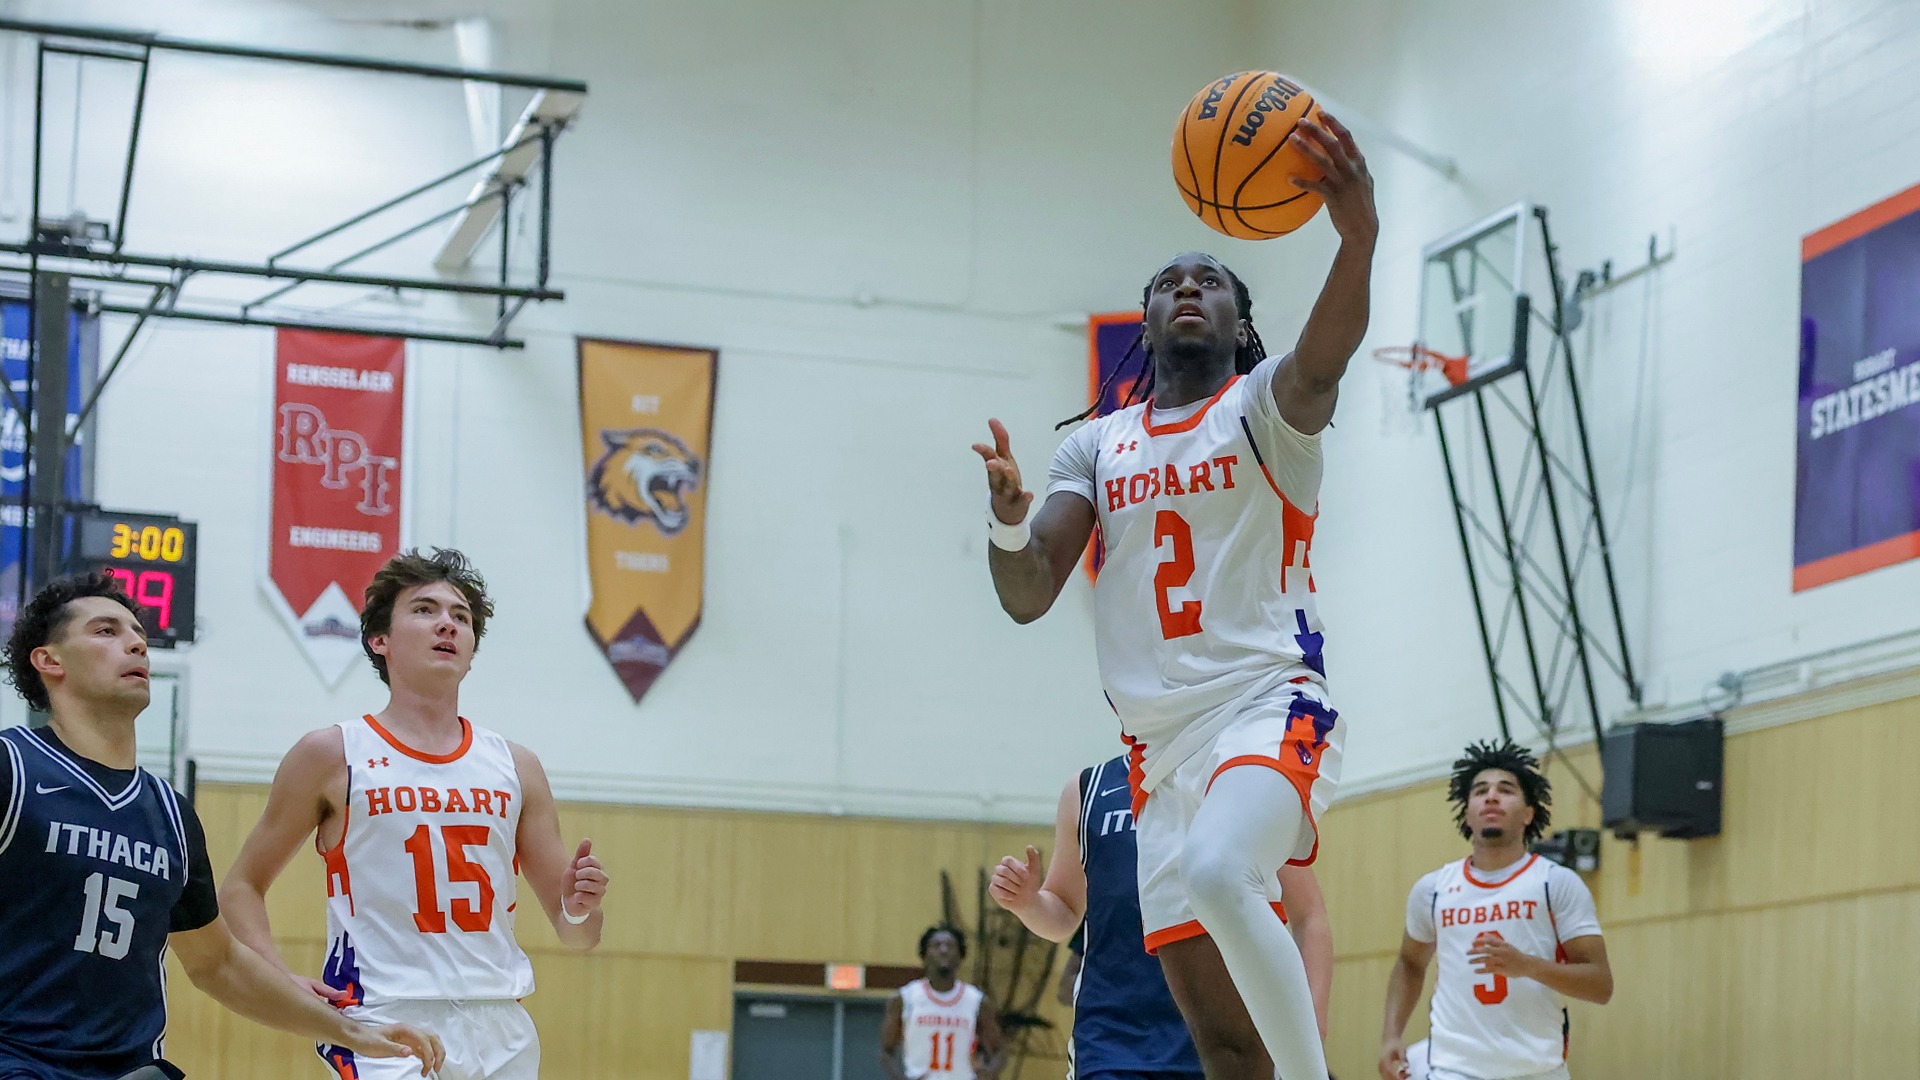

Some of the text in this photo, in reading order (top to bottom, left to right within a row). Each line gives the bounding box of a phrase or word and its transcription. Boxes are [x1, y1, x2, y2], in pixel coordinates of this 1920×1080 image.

[1198, 74, 1240, 121] CAA
[1231, 76, 1304, 147] Wilson
[286, 363, 394, 394] RENSSELAER
[279, 402, 399, 516] RPI
[1105, 455, 1238, 513] HOBART
[110, 523, 185, 562] 3:00
[290, 525, 382, 554] ENGINEERS
[1154, 510, 1203, 640] 2
[365, 786, 512, 819] HOBART
[45, 821, 171, 881] ITHACA
[405, 824, 495, 933] 15
[73, 872, 140, 961] 15
[1441, 900, 1538, 928] HOBART
[929, 1031, 955, 1073] 11
